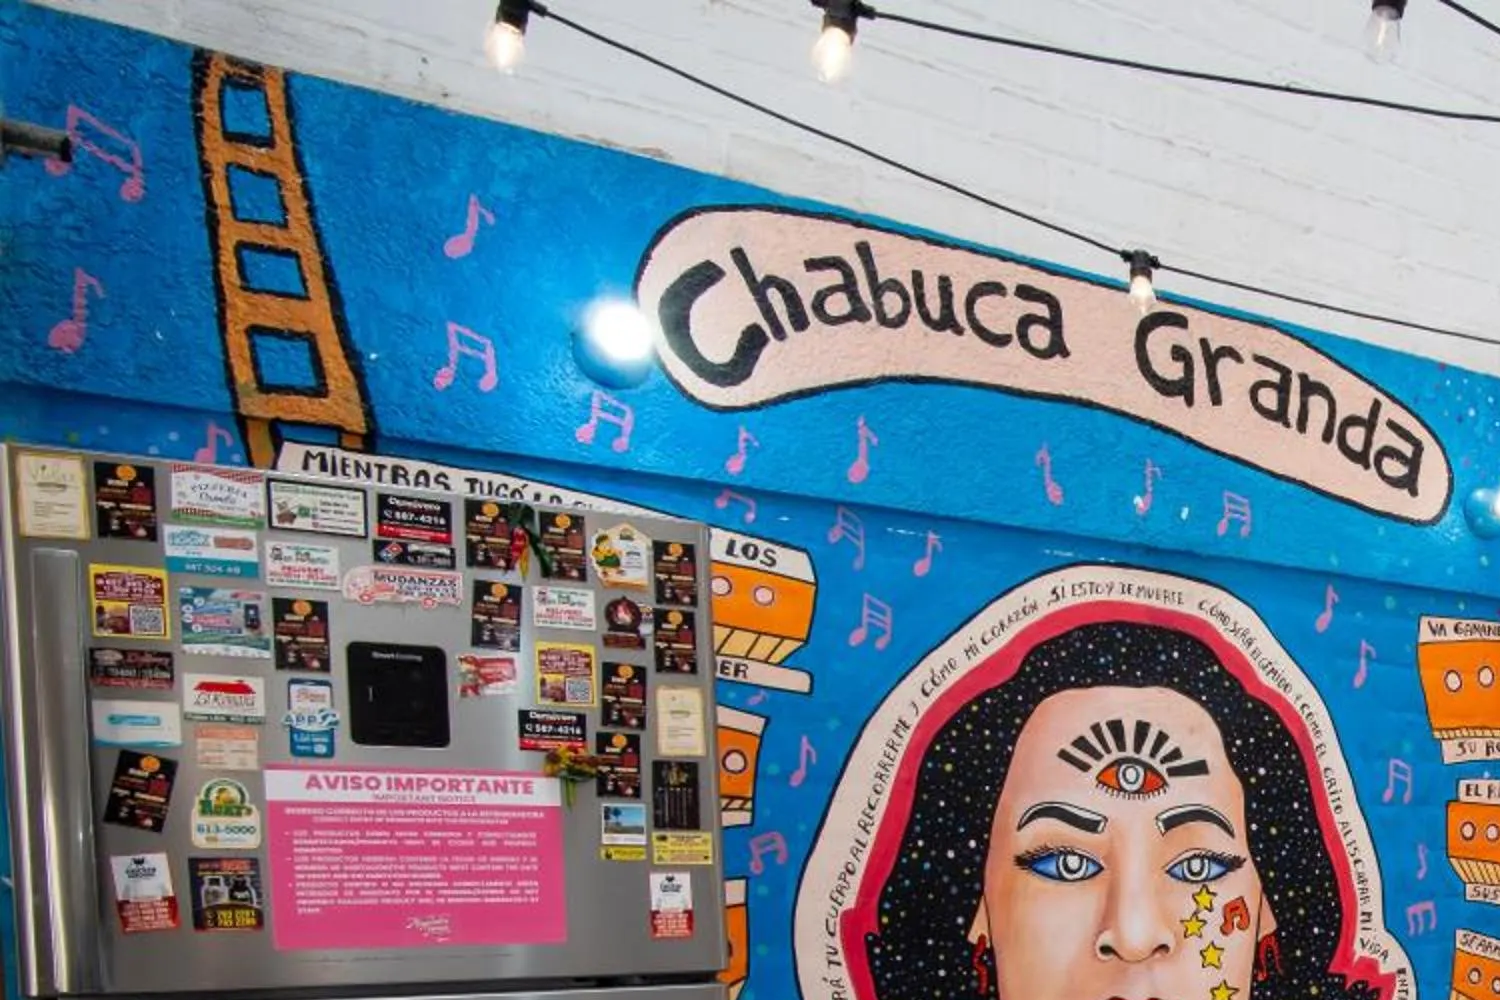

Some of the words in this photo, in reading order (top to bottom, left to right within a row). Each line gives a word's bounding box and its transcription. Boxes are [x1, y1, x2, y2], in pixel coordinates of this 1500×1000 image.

[658, 240, 1071, 388] Chabuca
[1134, 311, 1425, 497] Granda
[725, 539, 777, 567] LOS
[305, 774, 381, 791] AVISO
[386, 775, 534, 795] IMPORTANTE
